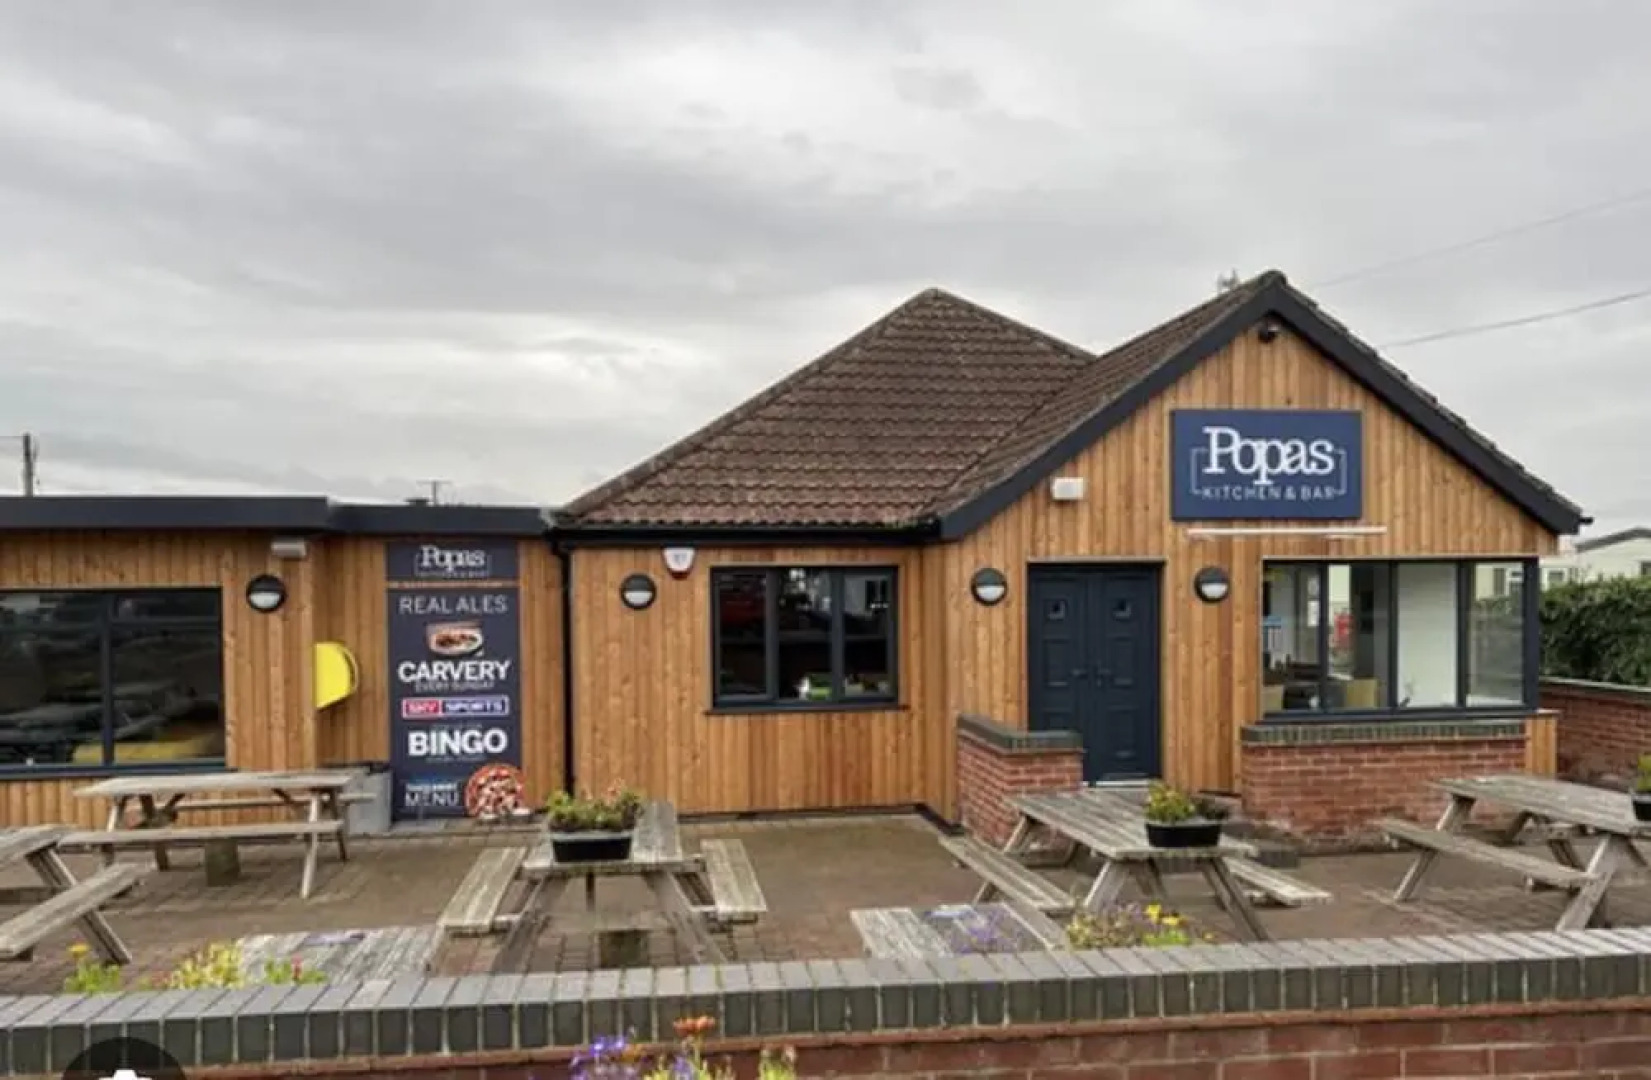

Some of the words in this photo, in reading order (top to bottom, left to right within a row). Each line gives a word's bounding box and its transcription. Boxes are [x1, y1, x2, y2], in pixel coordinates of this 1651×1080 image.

[1202, 425, 1335, 485] Popas
[1201, 486, 1282, 500] KITCHEN
[1285, 486, 1297, 500] &
[420, 544, 486, 572] Popas
[399, 595, 451, 614] REAL
[456, 594, 508, 613] ALES
[398, 659, 511, 682] CARVERY
[408, 727, 508, 756] BINGO
